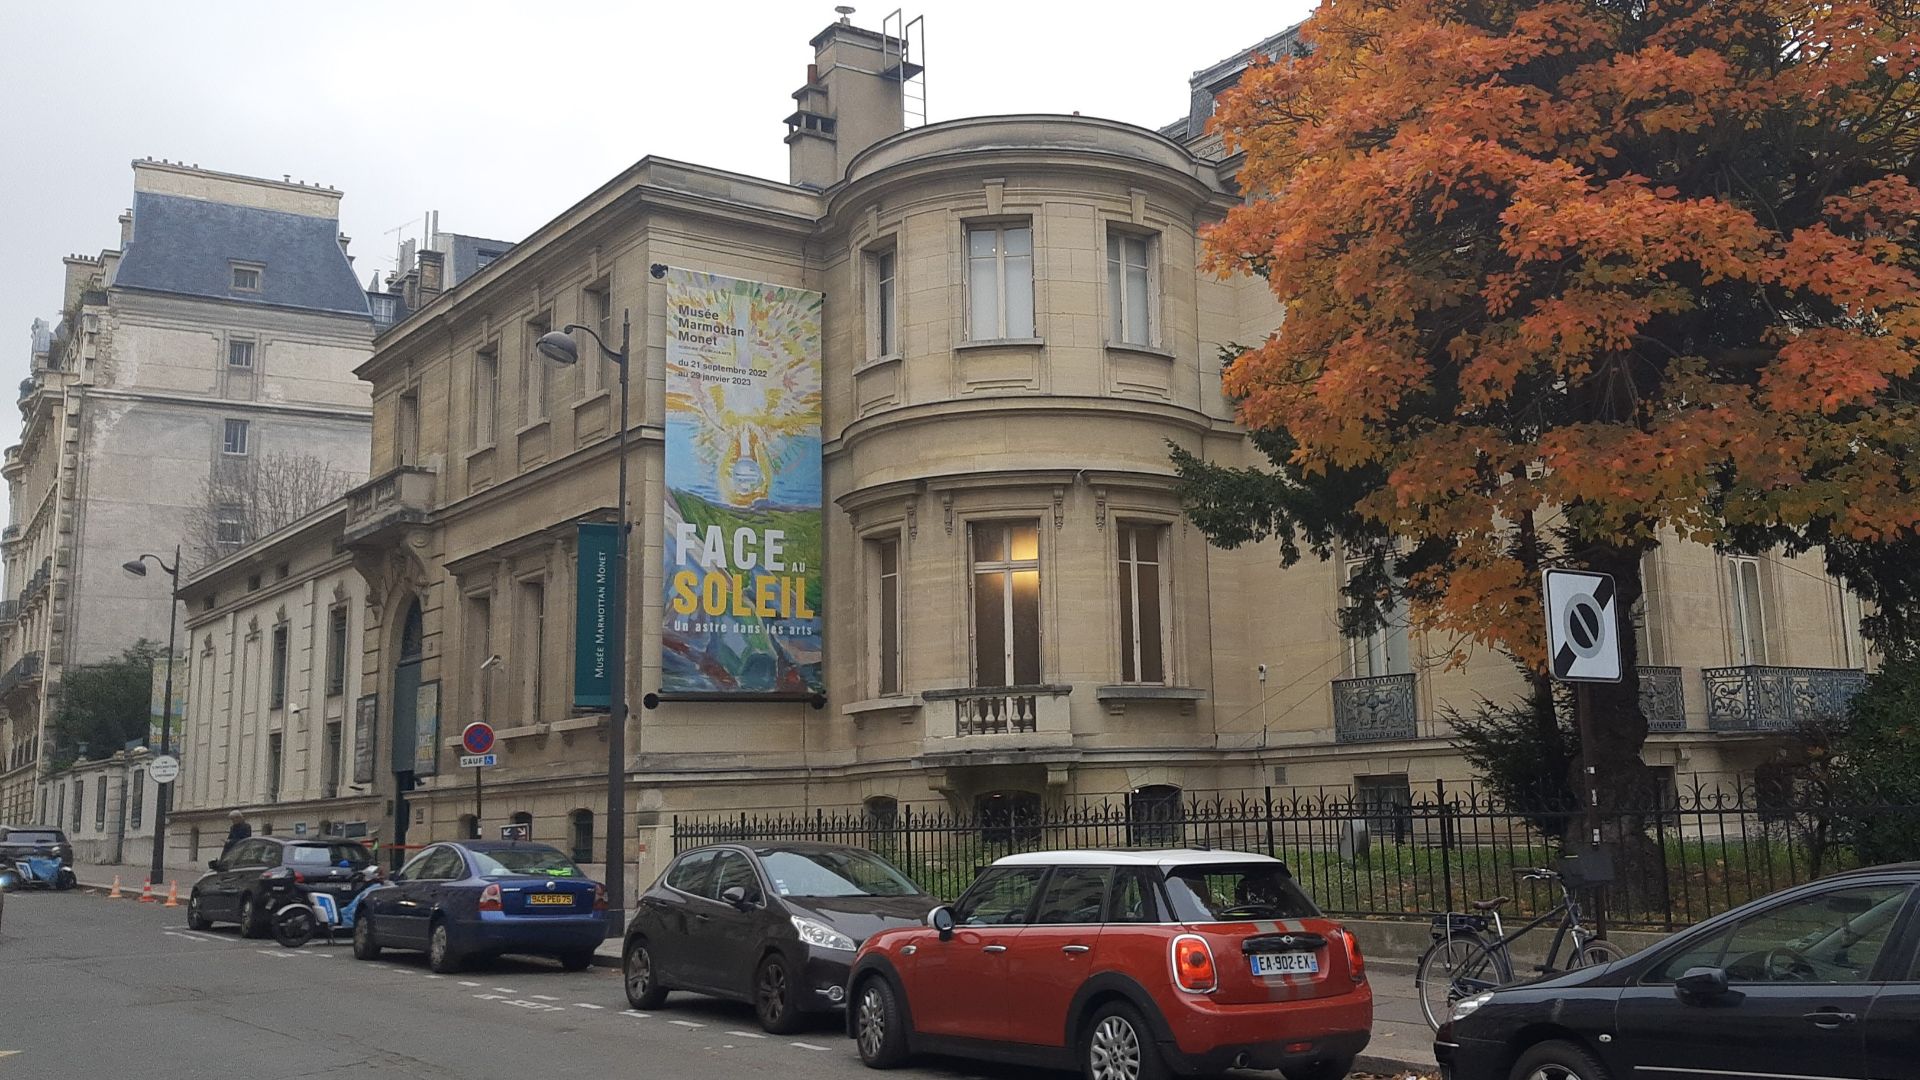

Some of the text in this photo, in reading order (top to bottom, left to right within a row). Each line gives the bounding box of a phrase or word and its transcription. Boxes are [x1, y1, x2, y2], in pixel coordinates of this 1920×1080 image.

[678, 304, 718, 320] Musée
[678, 318, 744, 336] Marmottan
[678, 331, 718, 346] Monet
[703, 363, 746, 375] septembre
[748, 369, 767, 377] 2022
[702, 373, 730, 383] janvier
[732, 376, 751, 385] 2023
[676, 523, 806, 572] FACE AU
[674, 570, 814, 618] SOLEIL
[674, 620, 812, 635] Un astre dans les arts
[462, 757, 483, 765] SAUF
[1259, 955, 1310, 970] EA-902-EX
